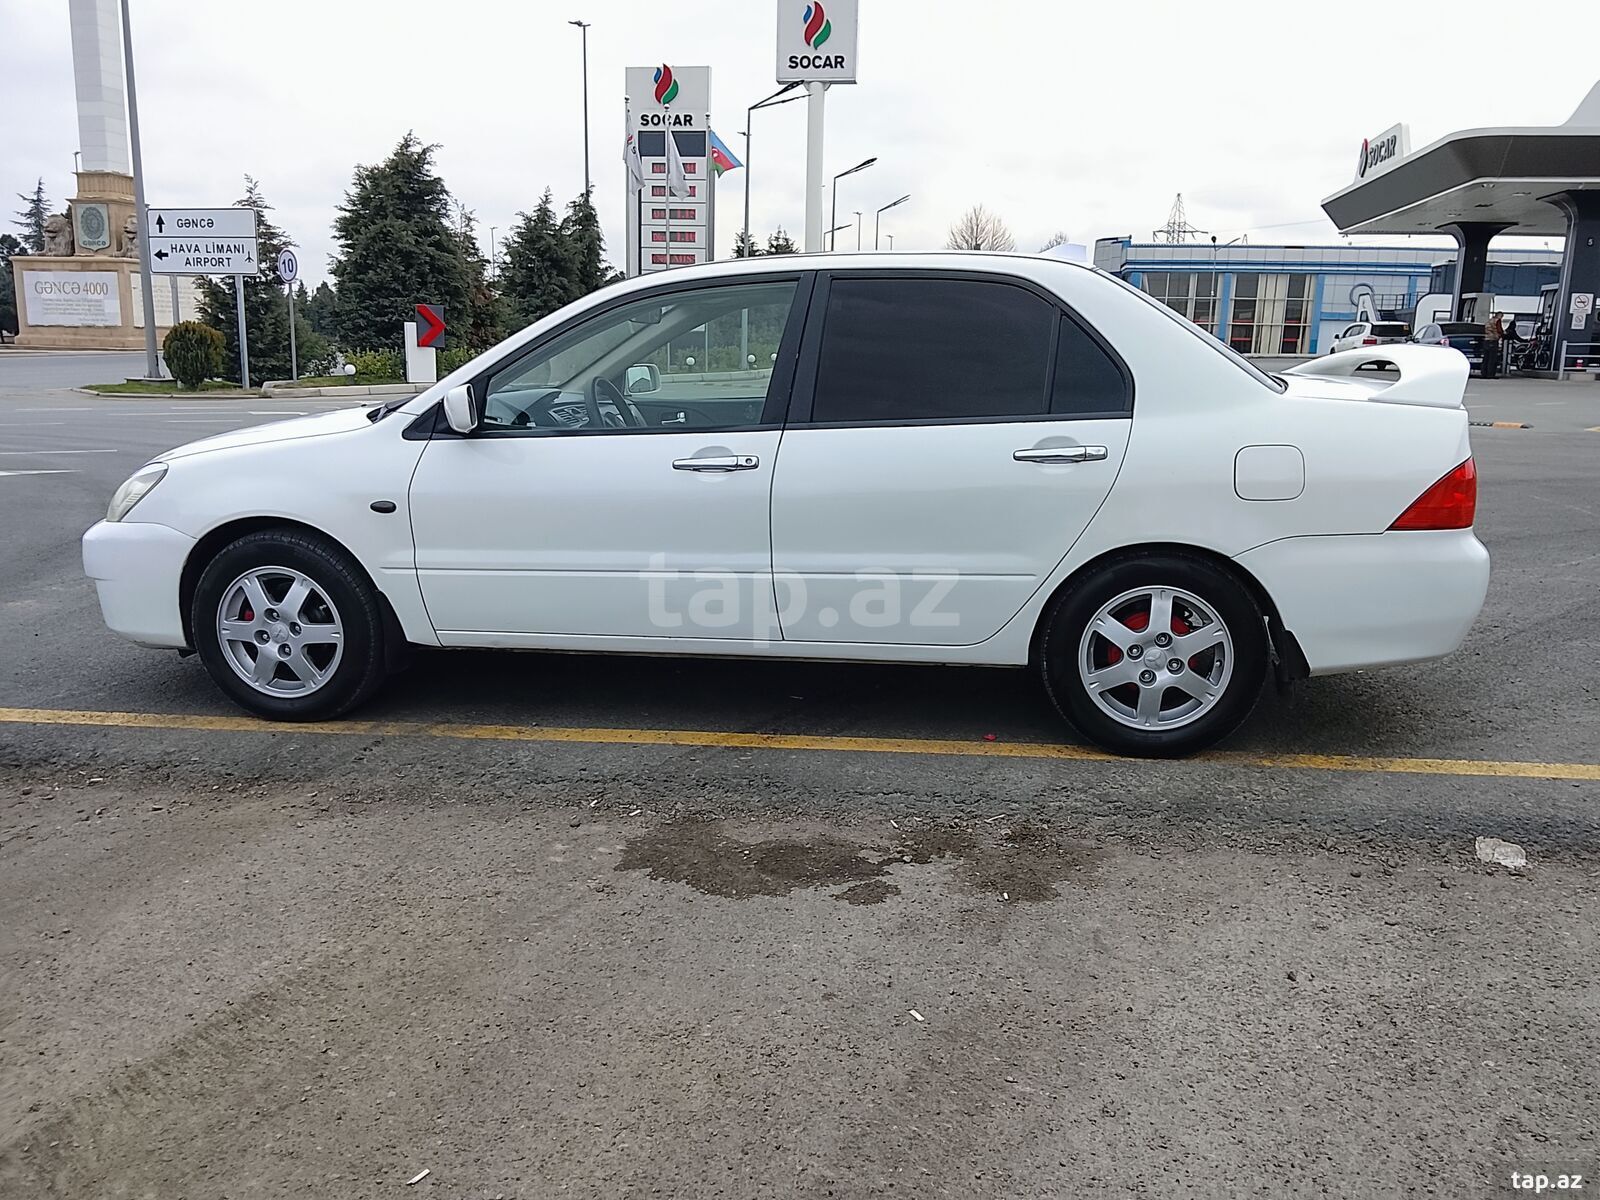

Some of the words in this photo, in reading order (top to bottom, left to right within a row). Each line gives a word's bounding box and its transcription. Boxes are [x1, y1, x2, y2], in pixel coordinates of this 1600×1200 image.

[788, 55, 845, 69] SOCAR
[1368, 134, 1397, 168] SOCAR
[176, 218, 214, 228] GƏNCƏ
[170, 244, 201, 254] HAVA
[205, 242, 245, 254] LİMANI
[184, 257, 232, 267] AIRPORT
[281, 258, 294, 274] 10
[34, 280, 81, 295] GƏNCƏ
[82, 282, 109, 296] 4000
